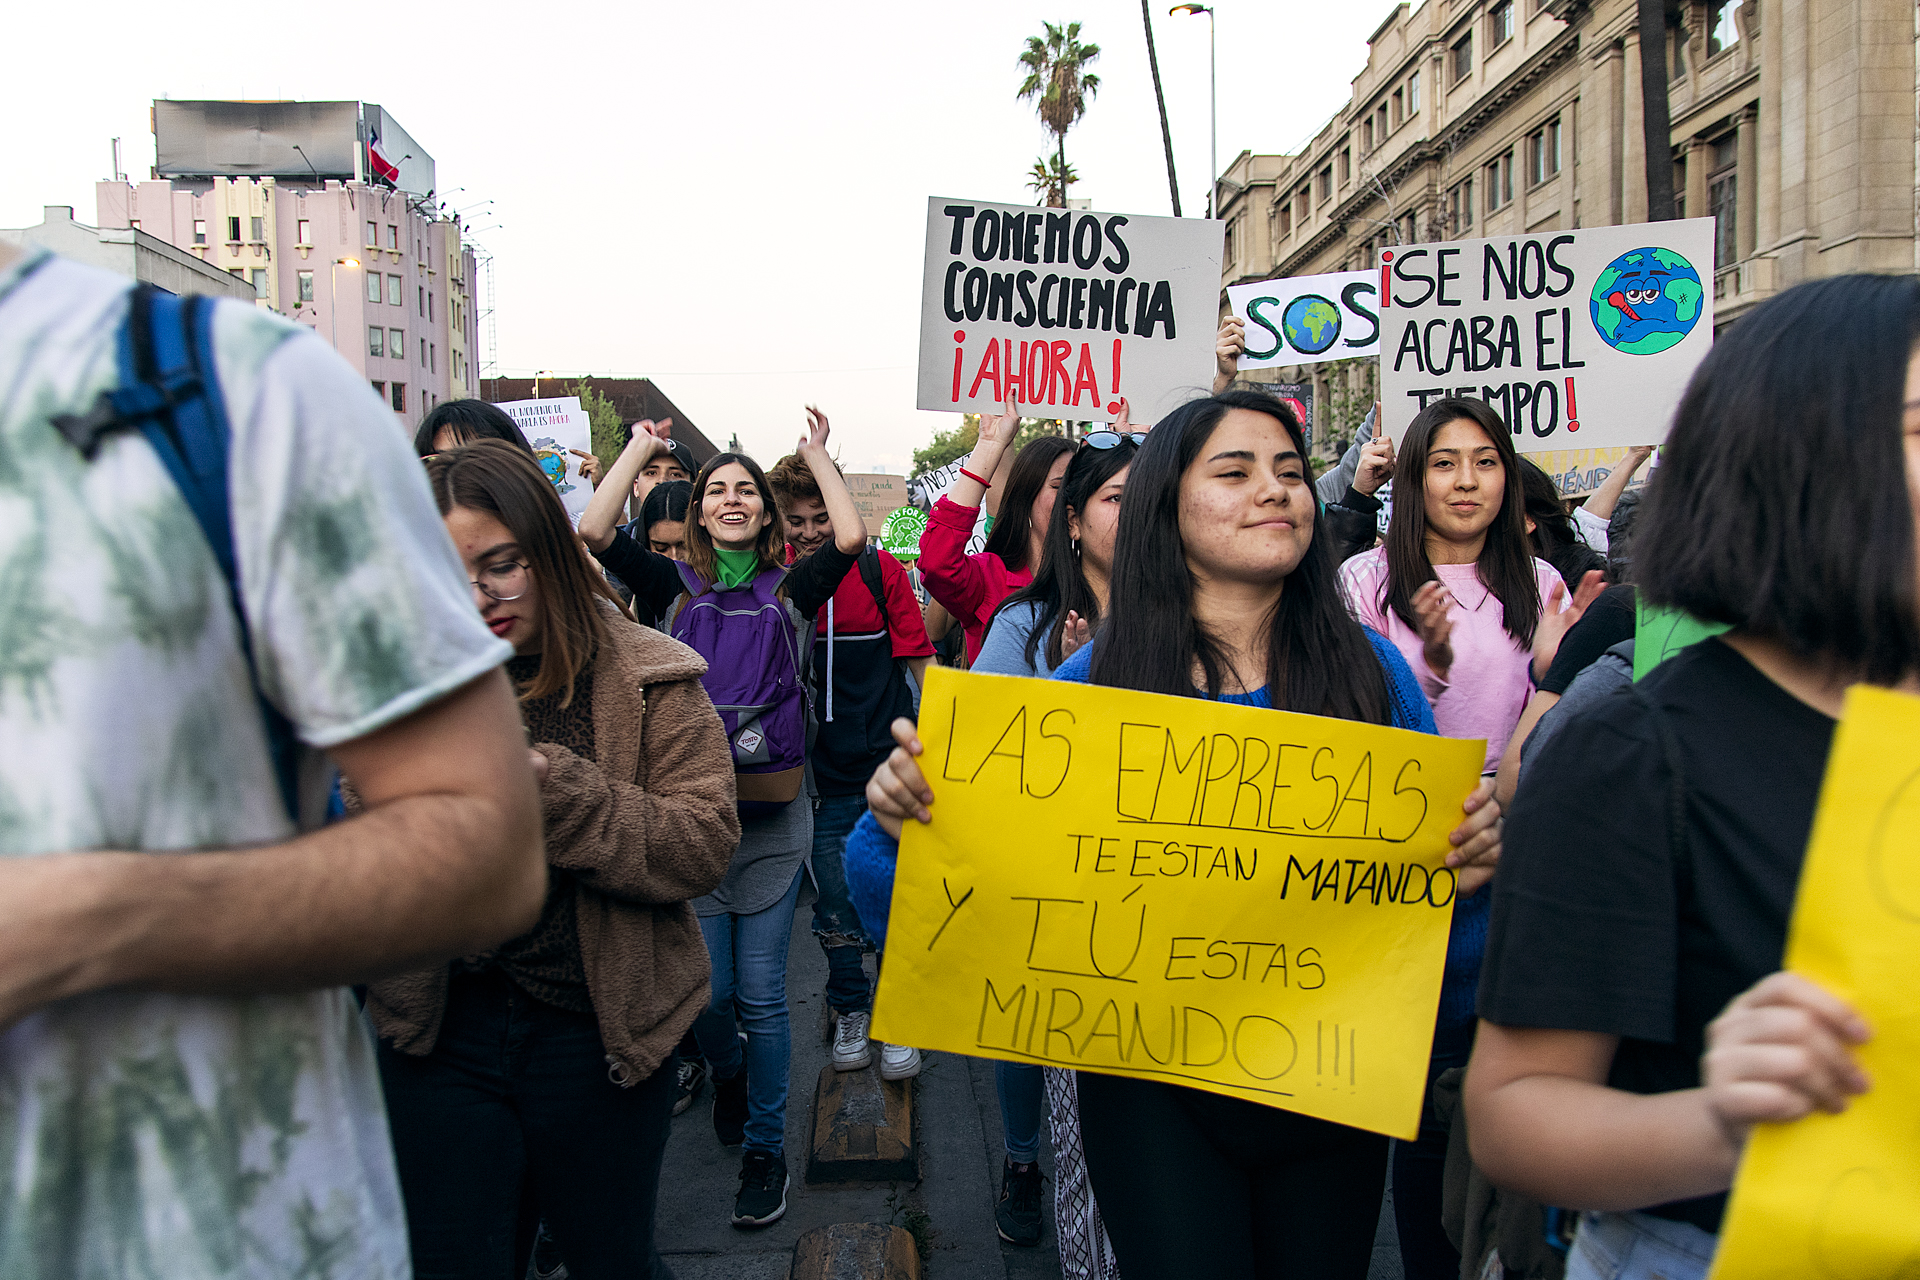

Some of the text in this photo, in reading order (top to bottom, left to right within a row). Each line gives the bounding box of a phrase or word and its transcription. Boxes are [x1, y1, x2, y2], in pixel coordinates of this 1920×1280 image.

[944, 205, 1130, 274] TOMEMOS
[1381, 235, 1575, 308] ¡SE NOS
[943, 261, 1176, 340] CONSCIENCIA
[1244, 282, 1379, 360] SOS
[952, 330, 1122, 415] ¡AHORA!
[1394, 308, 1585, 377] ACABA EL
[519, 405, 552, 416] MOMENTO
[554, 404, 562, 414] DE
[1407, 377, 1580, 438] TMPO!
[923, 470, 947, 494] NO
[882, 510, 901, 542] FRIDAYS
[902, 508, 919, 517] FOR
[889, 547, 921, 555] SANTIAG
[942, 696, 1429, 842] LAS EMPRESAS
[1067, 834, 1458, 908] TE ESTAN MATANDO
[928, 877, 1326, 990] Y TÚ ESTAS
